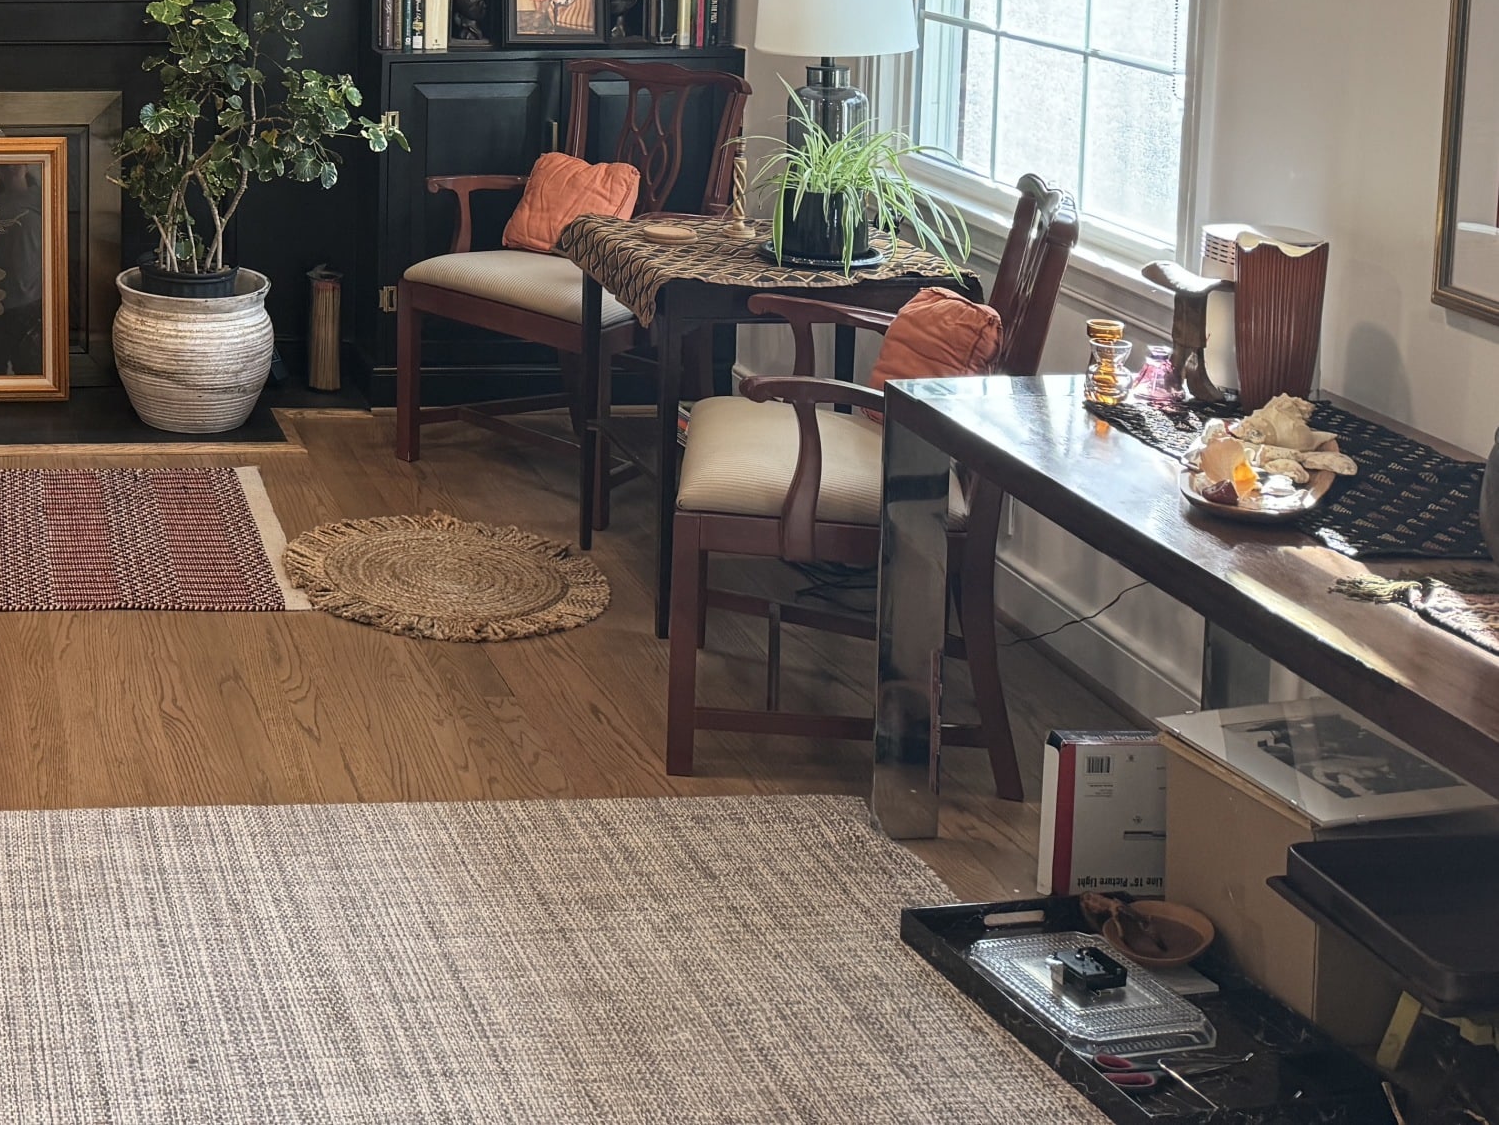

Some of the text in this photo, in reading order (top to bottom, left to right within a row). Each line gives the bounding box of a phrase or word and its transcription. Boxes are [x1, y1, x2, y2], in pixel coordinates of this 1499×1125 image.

[1077, 875, 1097, 888] Light
[1099, 876, 1128, 887] Picture
[1146, 877, 1163, 888] Line
